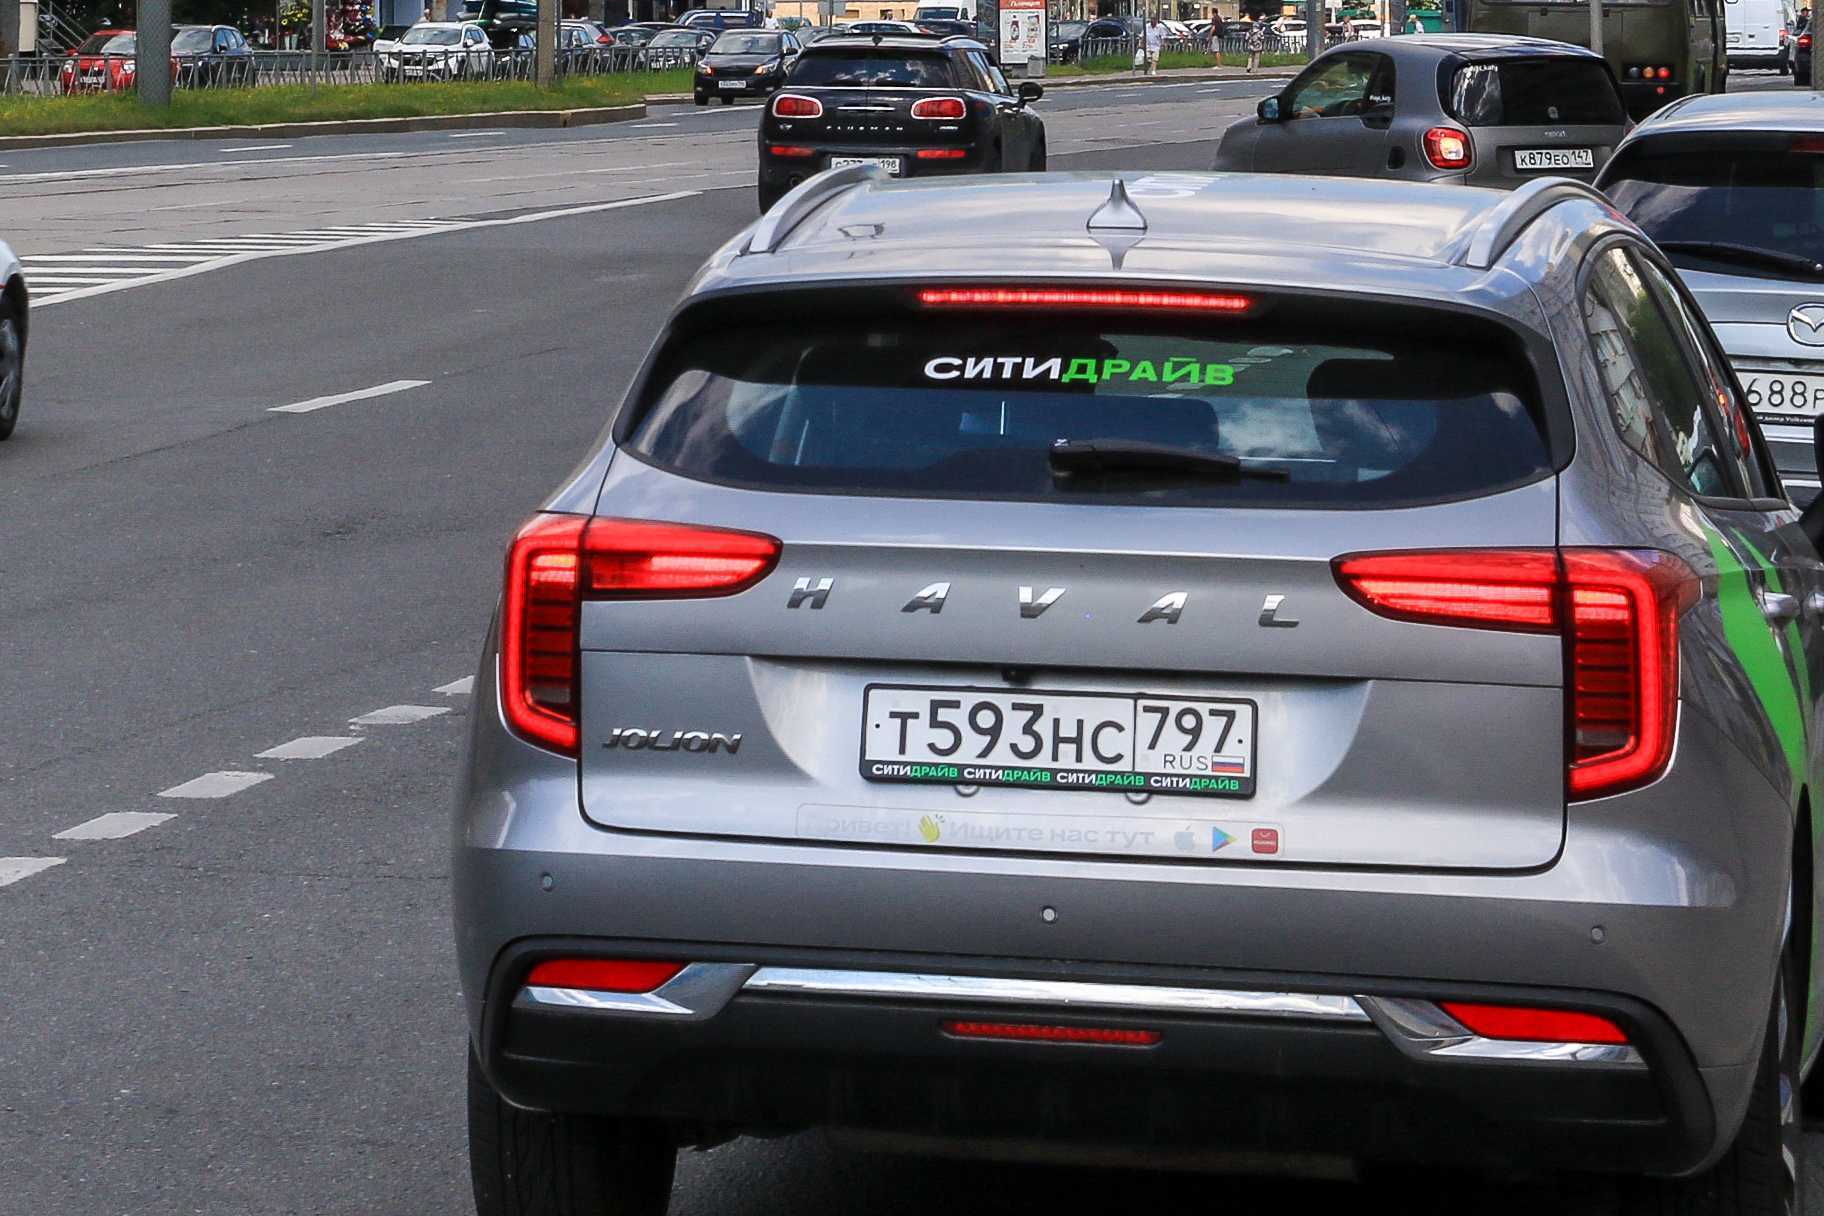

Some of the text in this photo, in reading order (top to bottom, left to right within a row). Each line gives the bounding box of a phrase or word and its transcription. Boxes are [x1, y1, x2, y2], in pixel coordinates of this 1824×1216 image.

[880, 159, 897, 169] 198
[1519, 150, 1591, 166] К879ЕО 147
[924, 355, 1235, 386] СИТИДРАЙВ
[786, 576, 1301, 629] HAVAL
[602, 726, 743, 755] JOLION
[888, 698, 1237, 765] Т593НС 797
[1163, 753, 1209, 772] RUS
[872, 763, 1240, 790] СИТИДРАЙВ СИТИДРАЙВ СИТИДРАЙВ СИТИДРАЙВ
[1049, 826, 1098, 843] нас
[1106, 829, 1155, 848] тут
